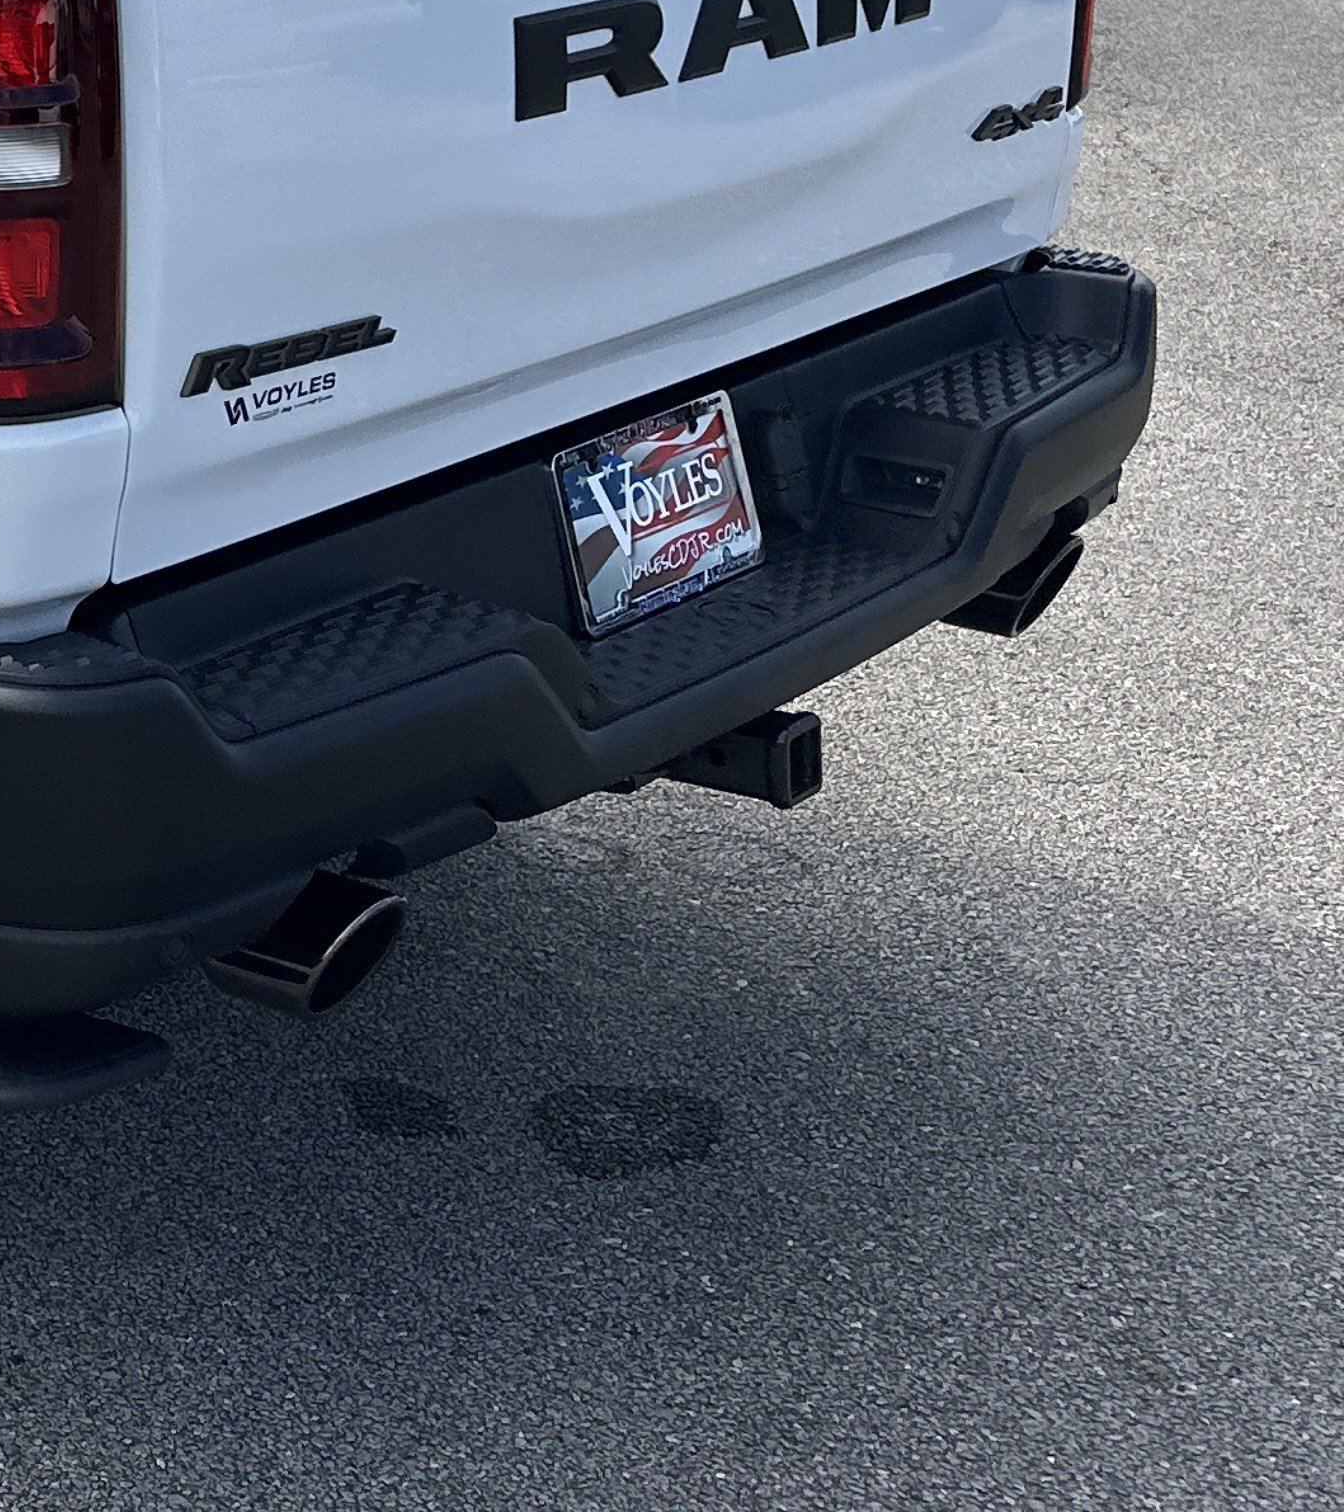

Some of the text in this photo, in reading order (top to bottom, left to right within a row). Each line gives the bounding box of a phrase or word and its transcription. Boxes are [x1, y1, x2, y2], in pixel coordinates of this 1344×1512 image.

[179, 314, 398, 398] REBEL
[252, 371, 337, 410] VOYLES
[587, 452, 723, 557] VOYLES
